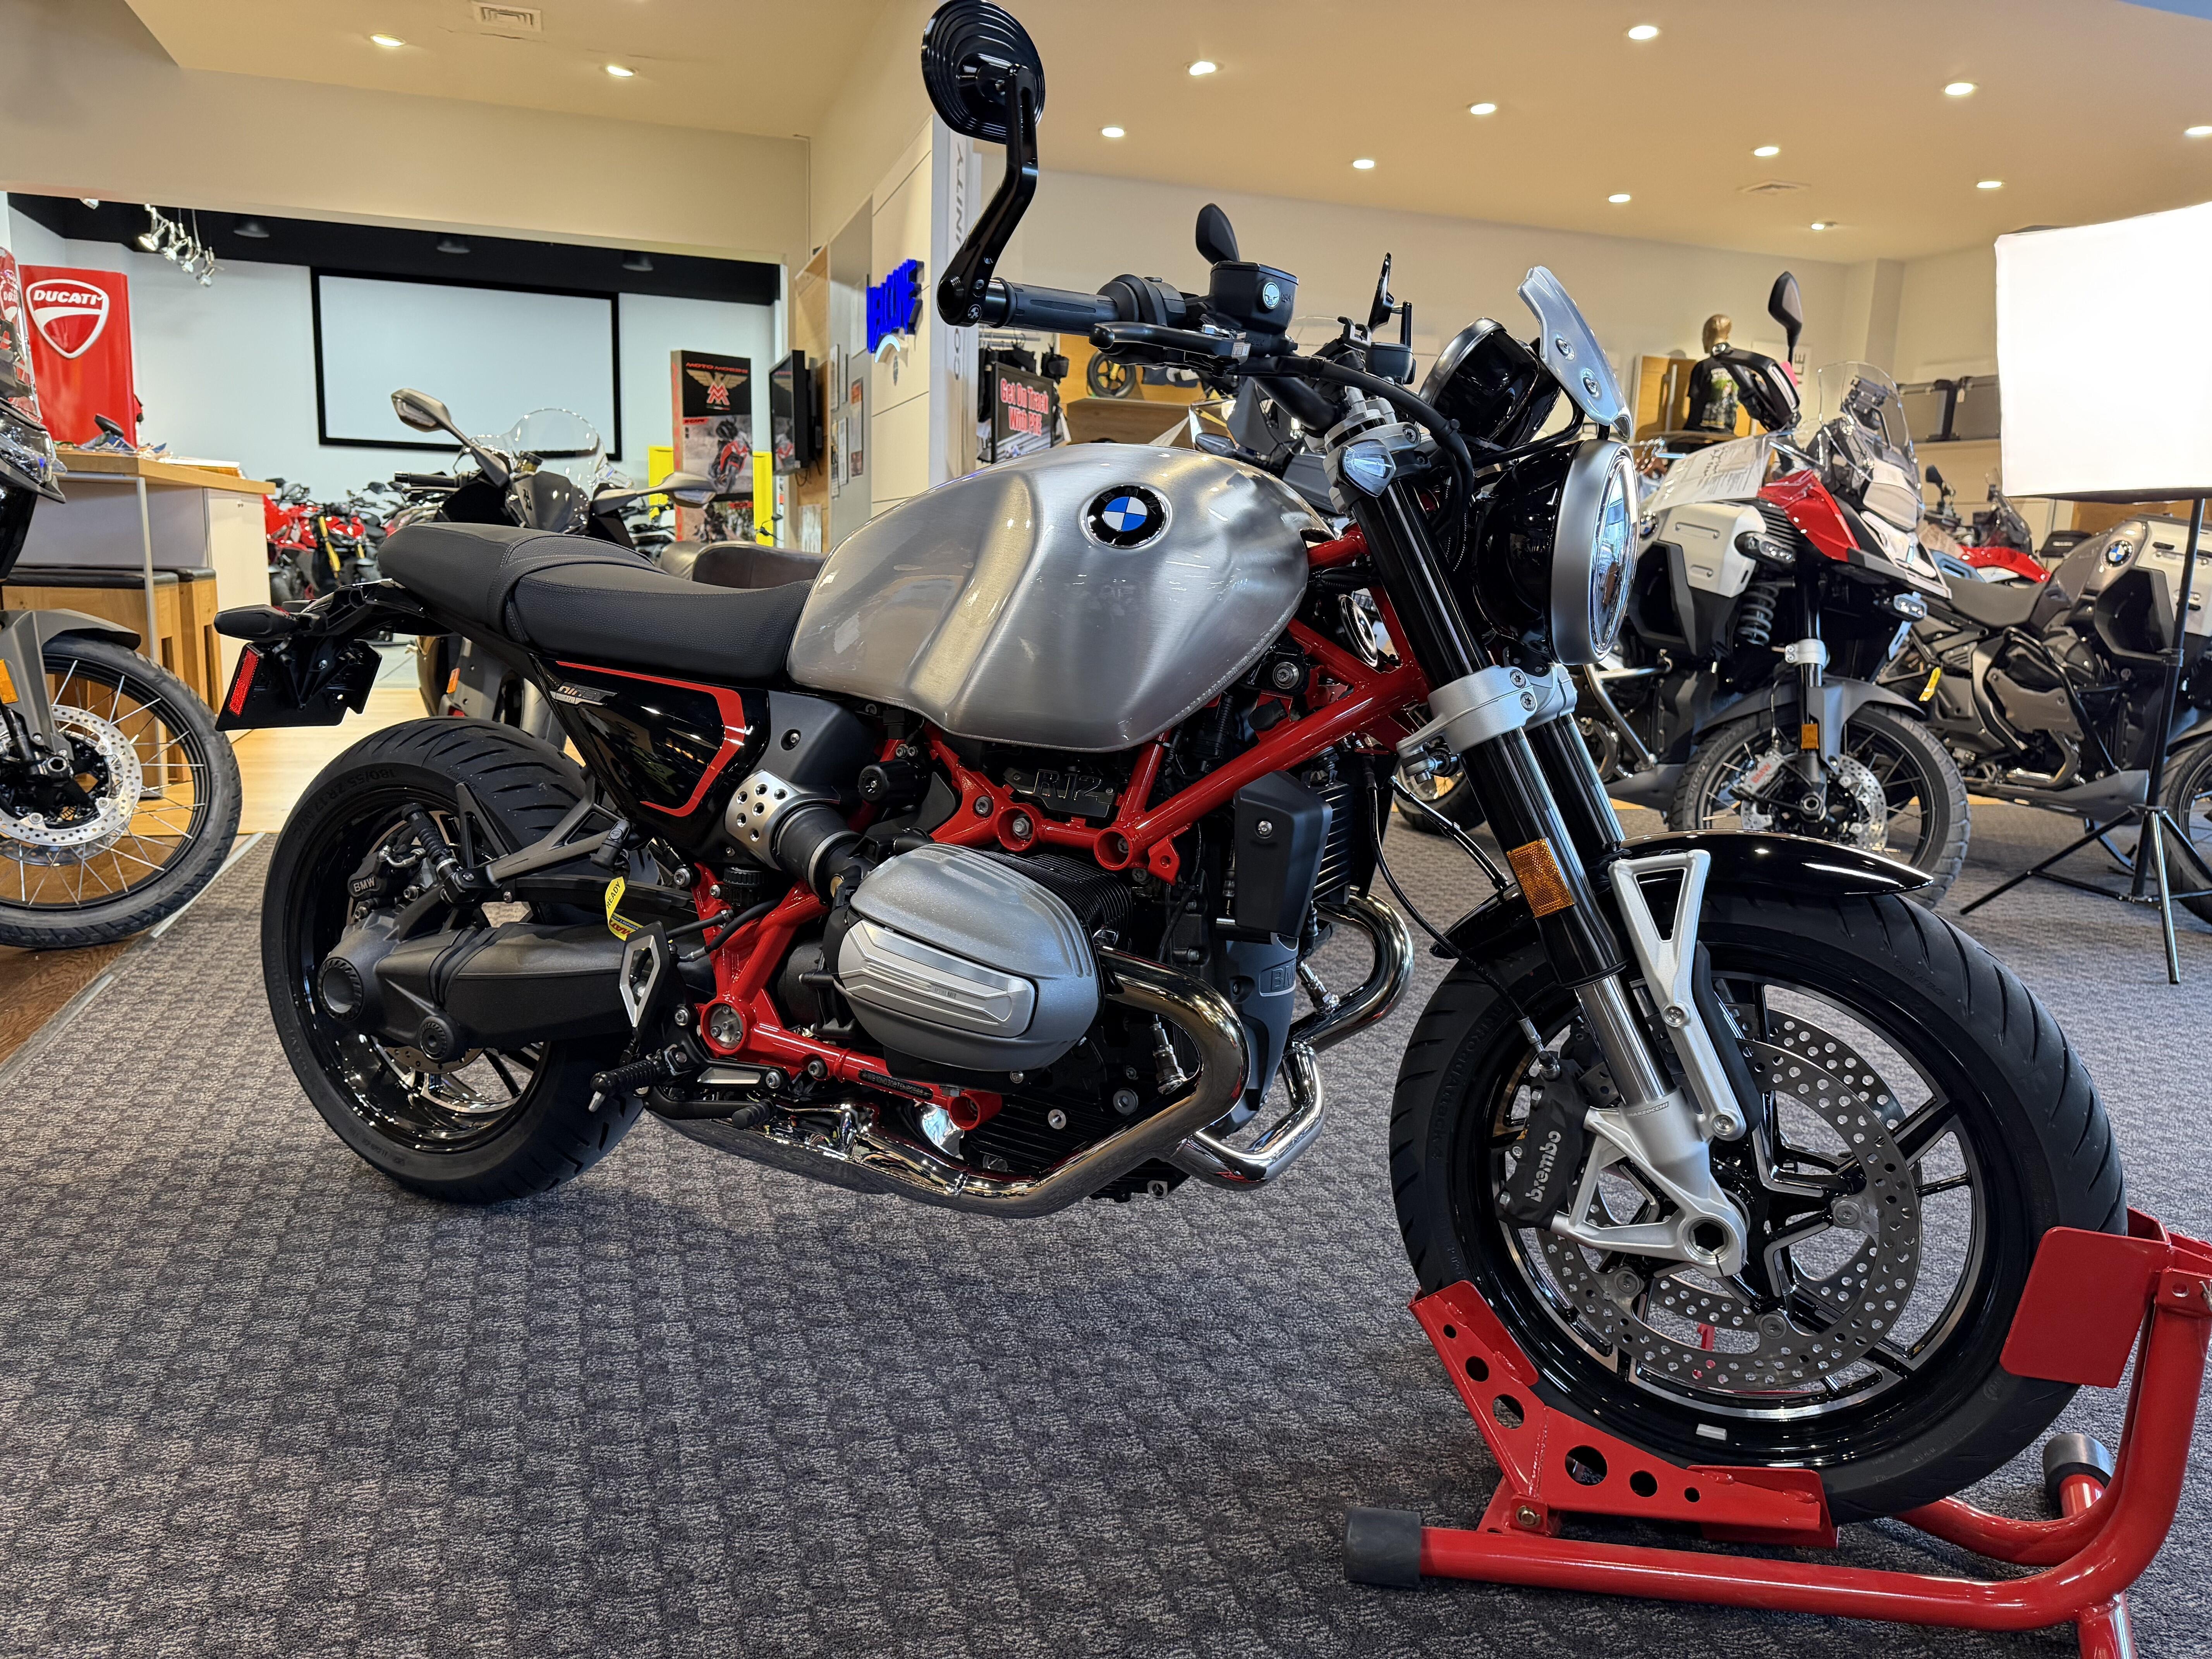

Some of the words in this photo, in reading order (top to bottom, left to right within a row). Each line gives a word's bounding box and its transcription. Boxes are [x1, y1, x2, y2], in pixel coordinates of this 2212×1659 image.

[33, 290, 98, 305] DUCATI
[1101, 488, 1159, 515] BMW
[354, 876, 374, 892] BMW
[606, 881, 621, 909] READY
[1271, 962, 1296, 991] BM
[1525, 1131, 1561, 1202] brembo
